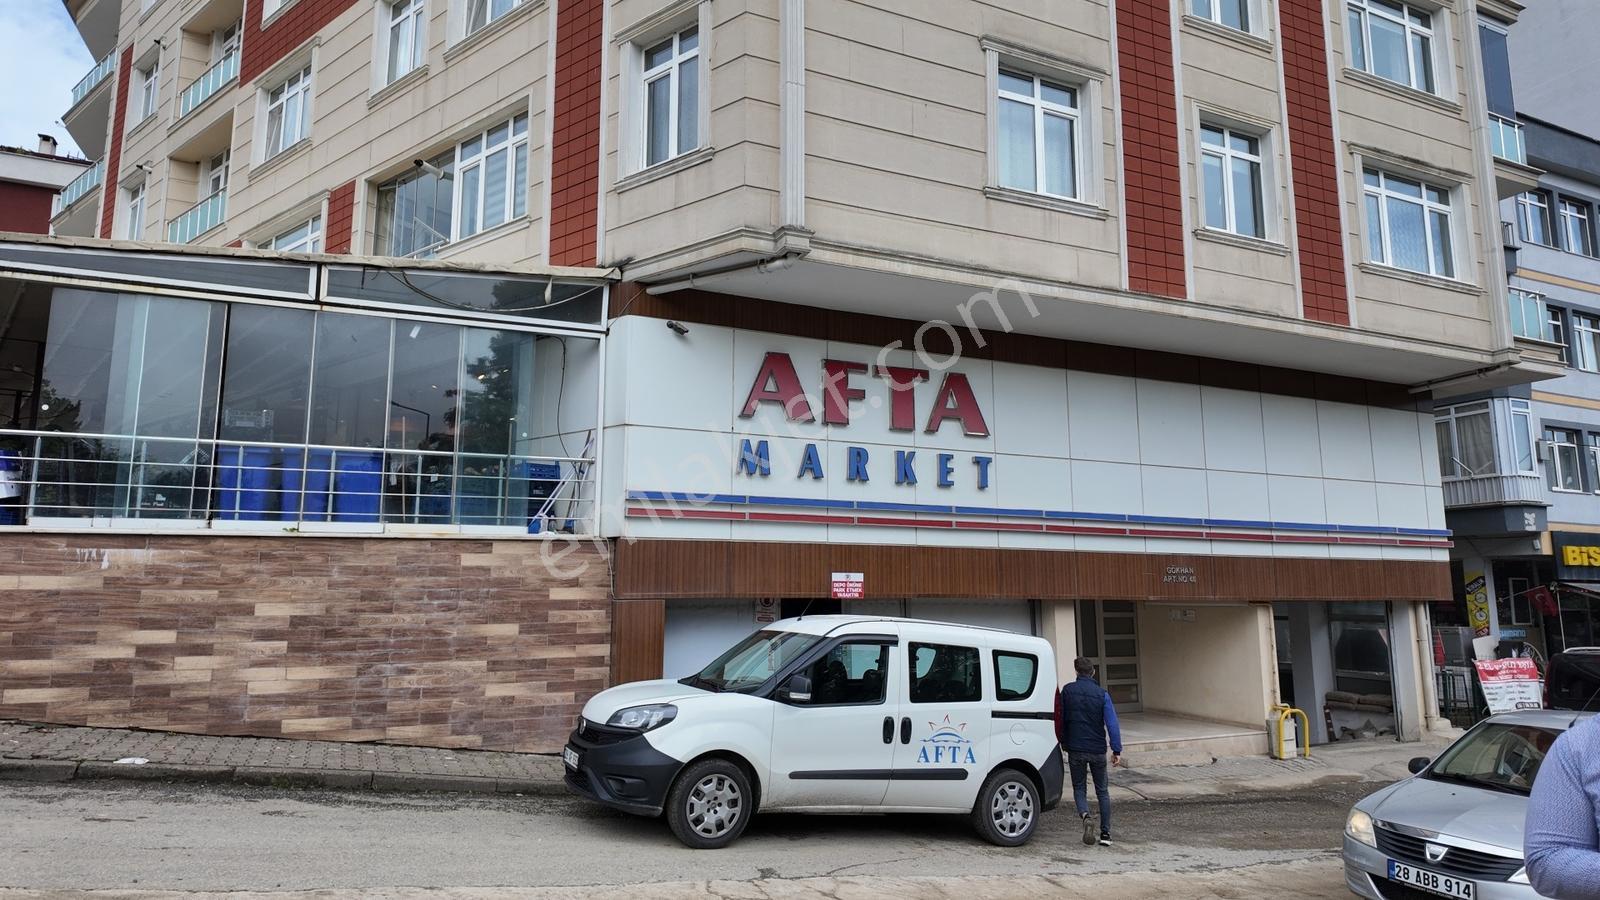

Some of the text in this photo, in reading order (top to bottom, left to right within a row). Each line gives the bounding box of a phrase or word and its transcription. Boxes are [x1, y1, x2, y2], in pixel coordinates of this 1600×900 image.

[738, 351, 991, 436] AFTA
[737, 439, 993, 490] MARKET
[917, 745, 977, 764] AFTA
[1395, 865, 1410, 880] 28
[1415, 870, 1439, 889] ABB
[1444, 879, 1472, 898] 914
